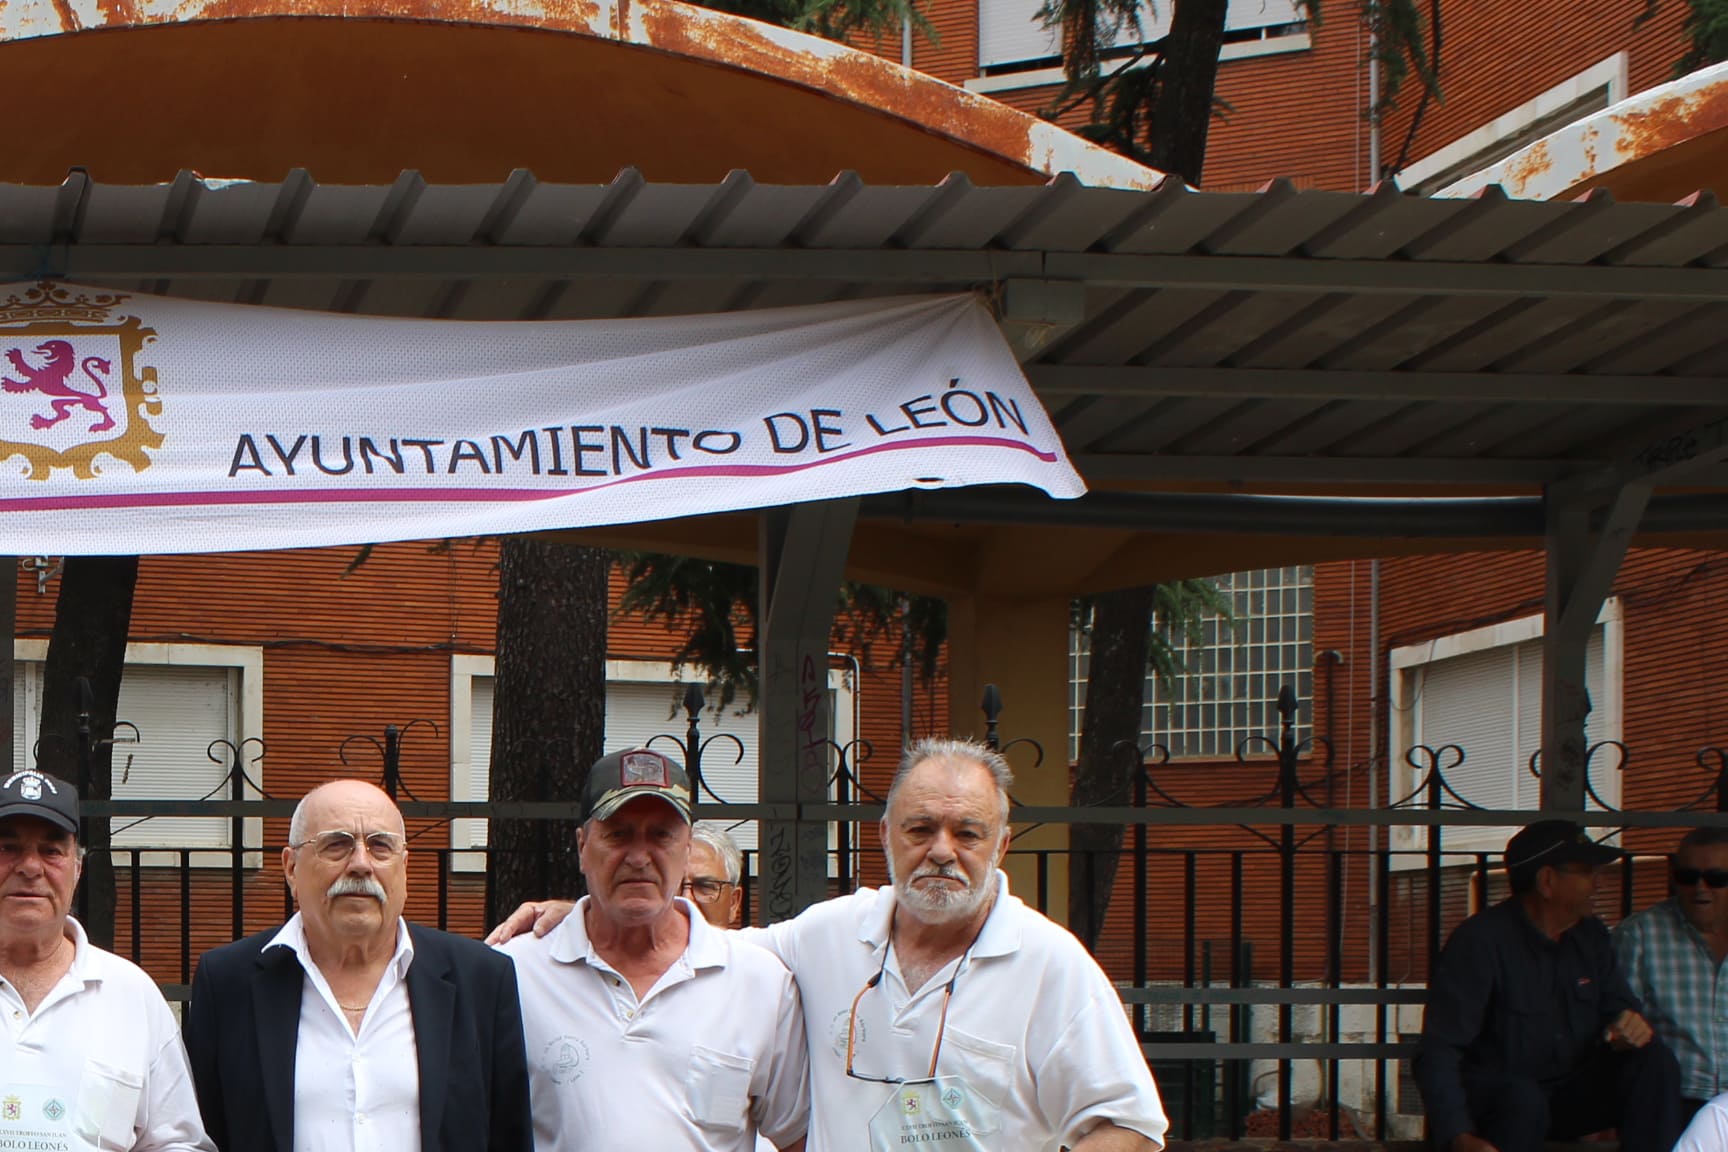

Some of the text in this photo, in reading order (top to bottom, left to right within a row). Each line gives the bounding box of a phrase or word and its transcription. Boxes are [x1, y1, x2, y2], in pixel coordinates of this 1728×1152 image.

[228, 378, 1029, 478] AYUNTAMIENTO DE LEÓN
[901, 1132, 929, 1144] BOLO
